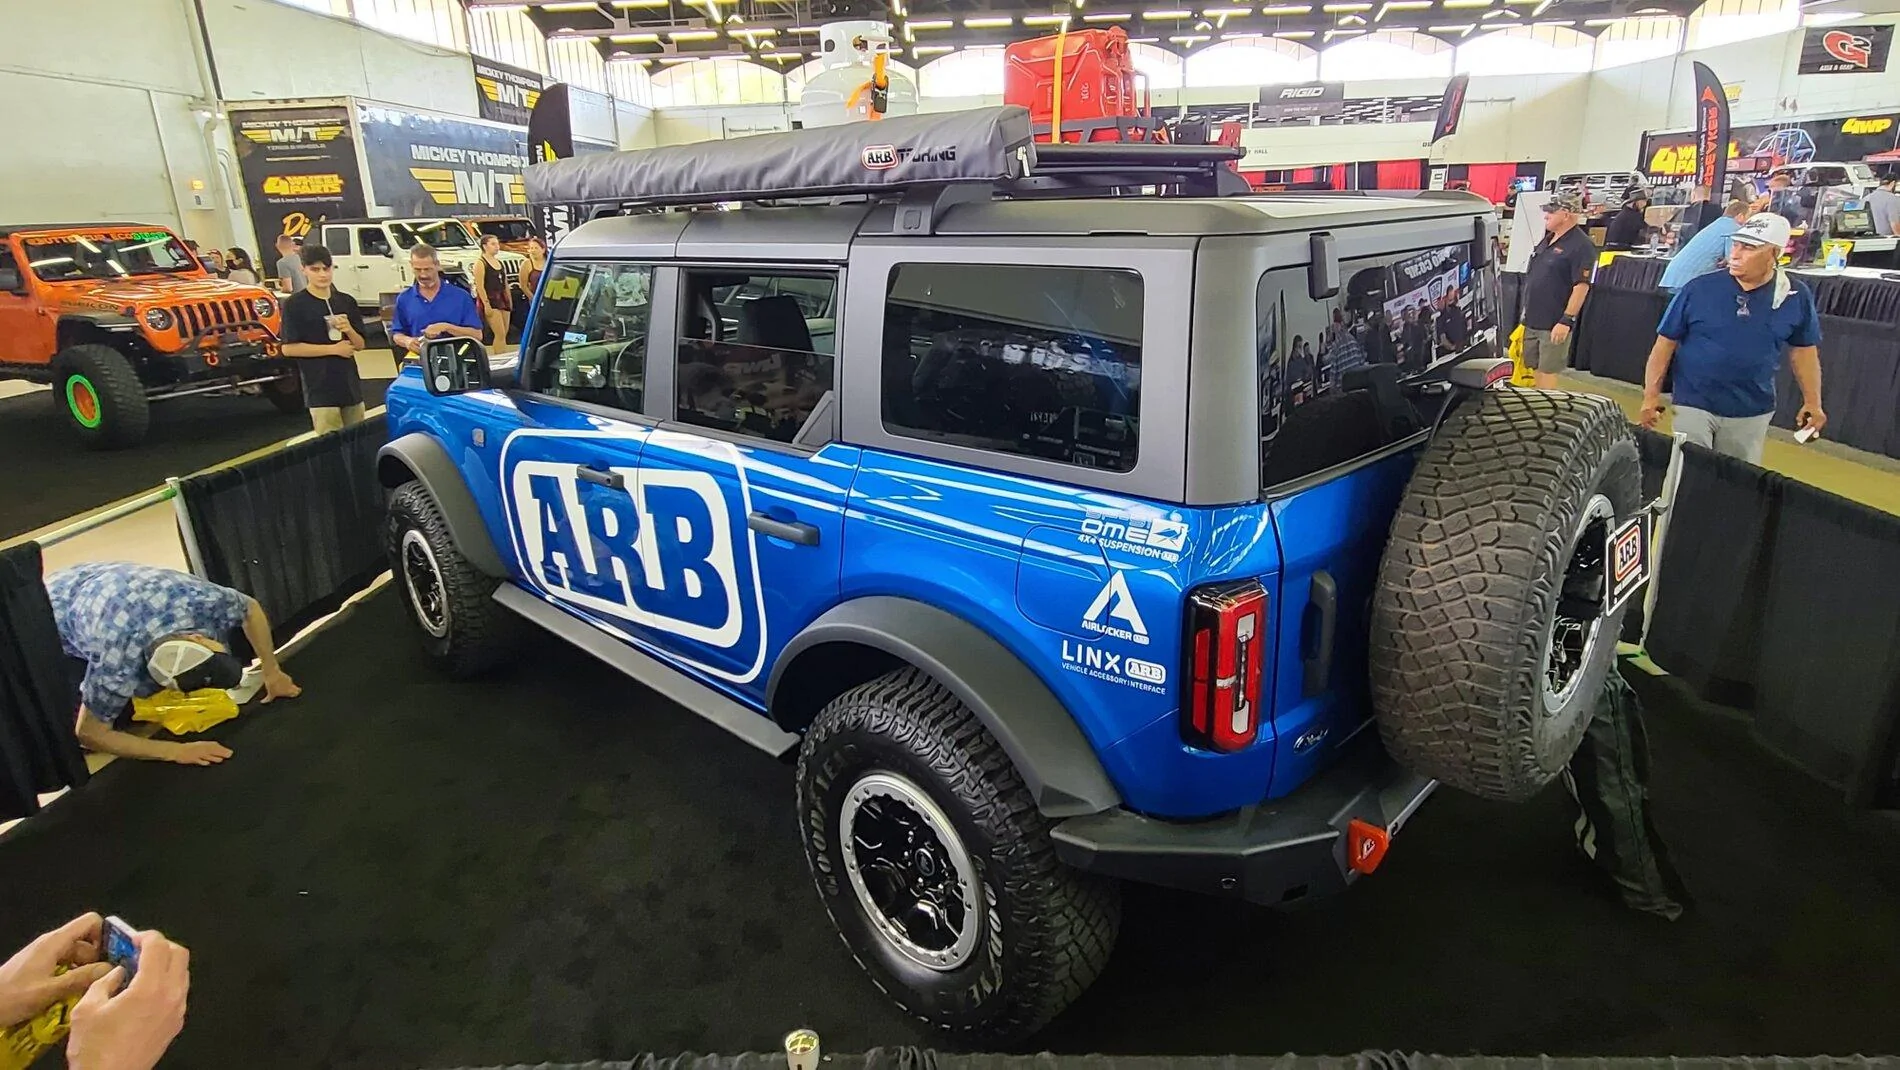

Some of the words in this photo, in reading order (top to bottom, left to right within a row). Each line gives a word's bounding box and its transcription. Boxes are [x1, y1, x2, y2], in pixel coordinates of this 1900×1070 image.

[1279, 86, 1325, 99] RIGID
[1841, 117, 1892, 134] 4WP
[410, 145, 465, 163] MICKEY
[467, 150, 529, 169] THOMPSO
[867, 150, 893, 164] ARB
[528, 474, 730, 629] ARB
[1098, 538, 1161, 559] SUSPENSION
[1618, 535, 1638, 570] ARB
[1062, 640, 1120, 674] LINX
[1129, 661, 1163, 681] ARB
[1061, 662, 1088, 676] VEHICLE
[1089, 669, 1127, 685] ACCESSORY
[1127, 680, 1166, 695] INTERFACE
